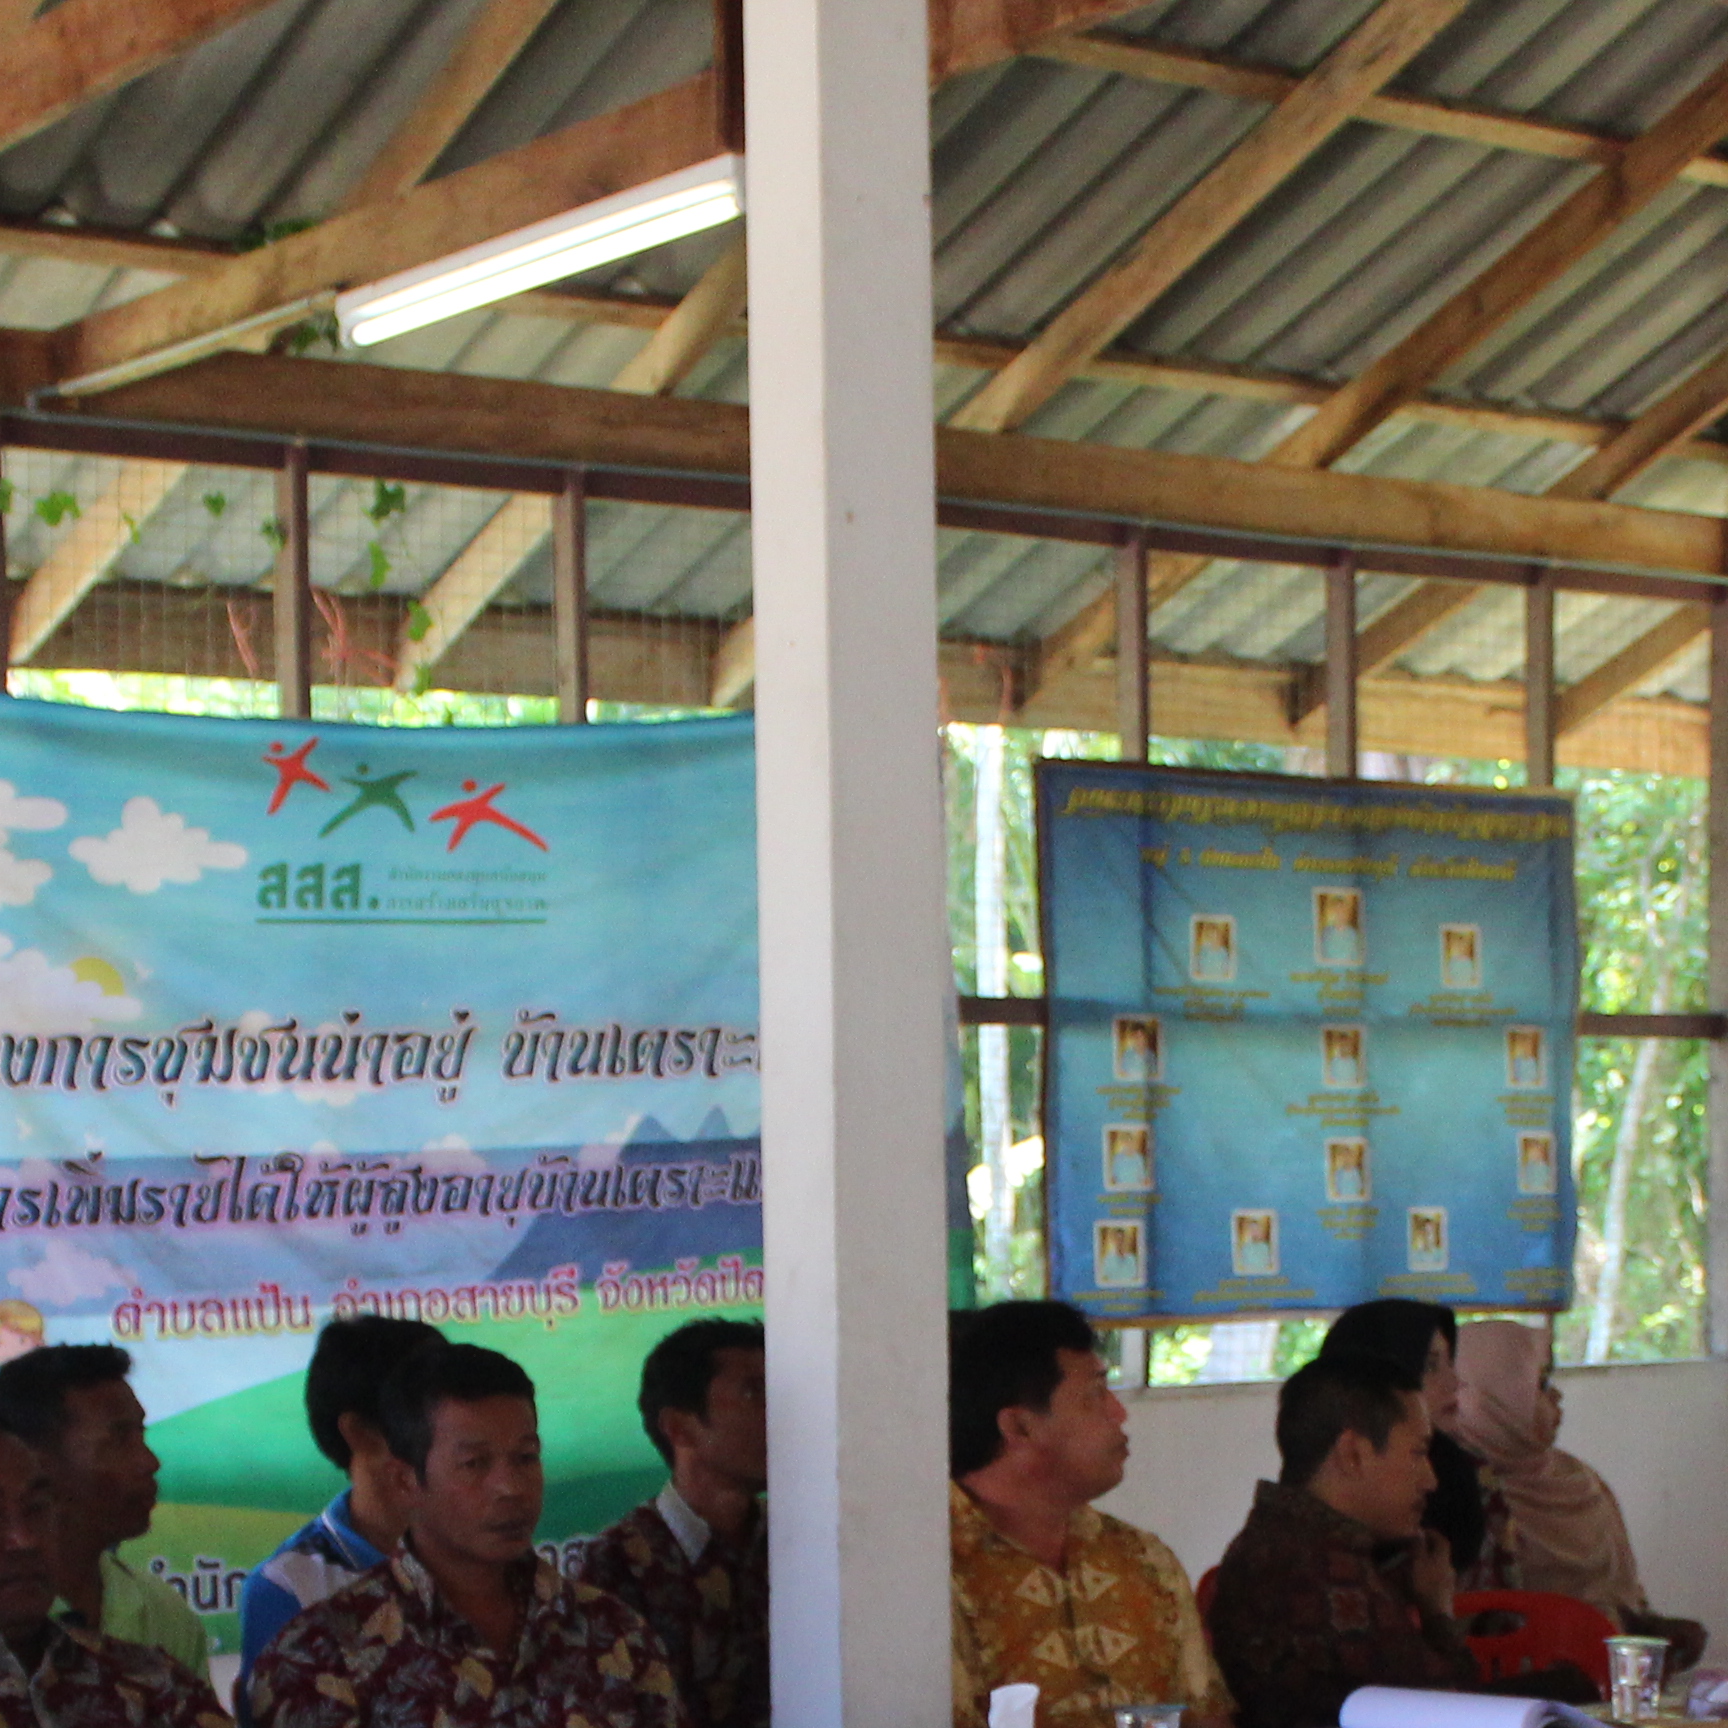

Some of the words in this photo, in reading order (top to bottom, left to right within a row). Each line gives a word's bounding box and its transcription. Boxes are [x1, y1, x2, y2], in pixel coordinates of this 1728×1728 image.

[257, 862, 380, 911] สสส.
[500, 1007, 760, 1083] บ้านเตราะ
[113, 1284, 315, 1338] ตำบลแป้น
